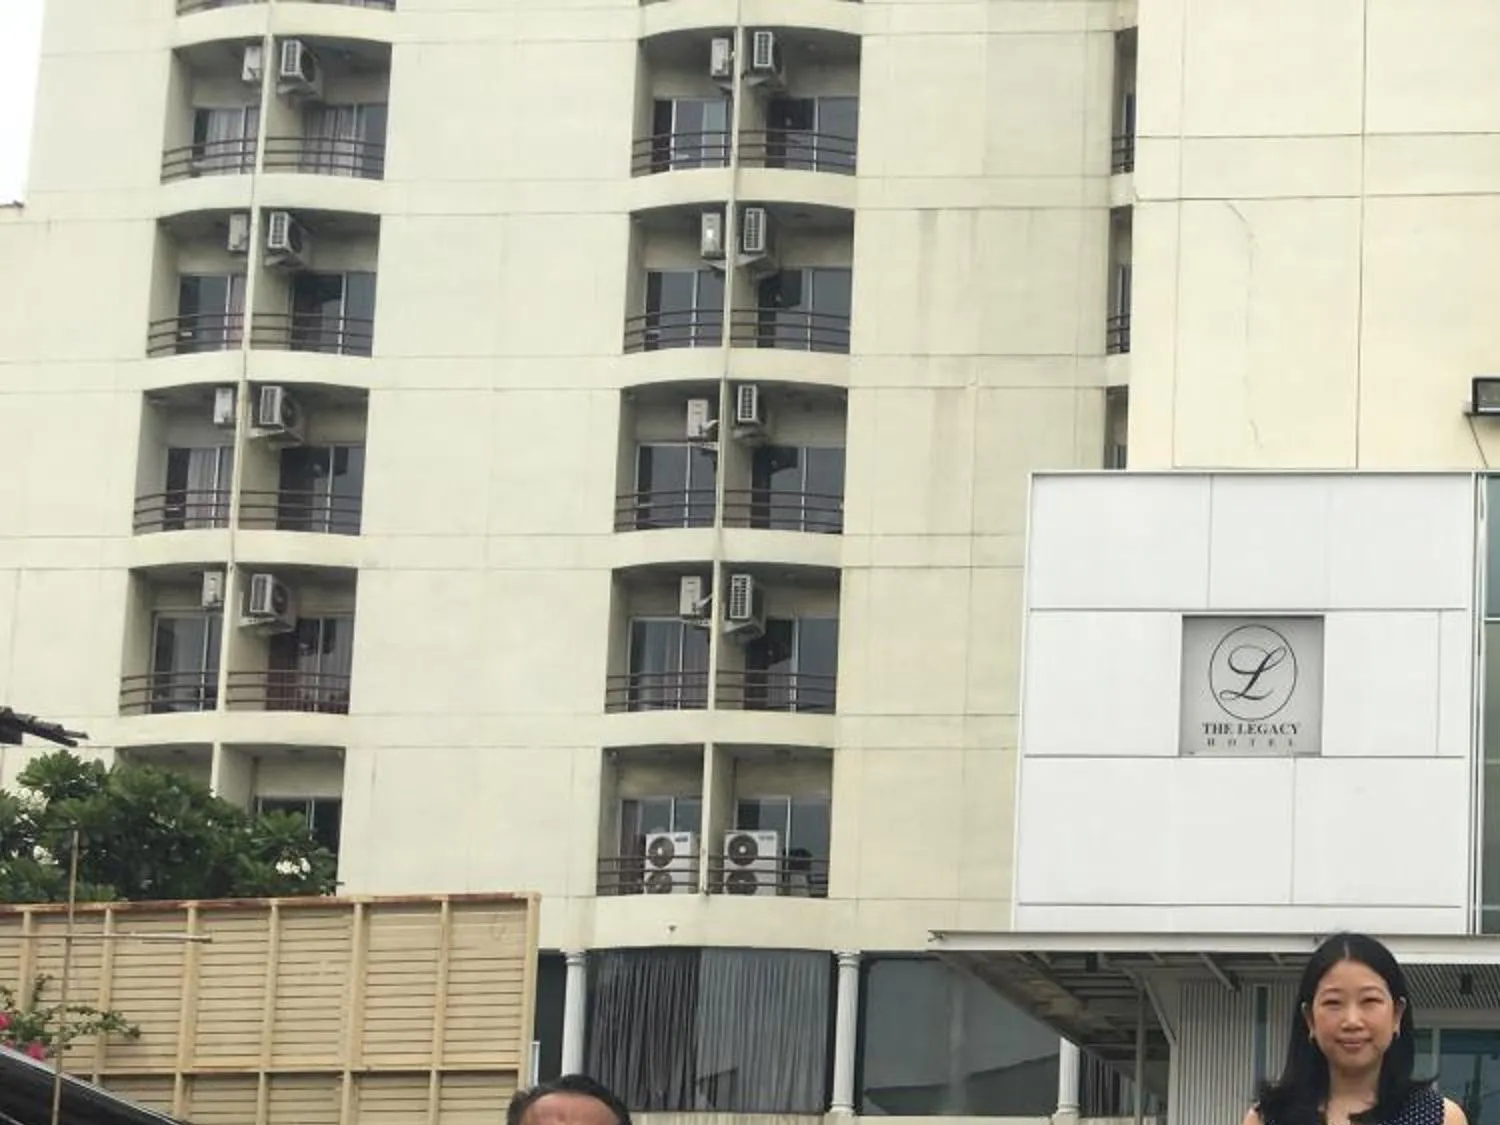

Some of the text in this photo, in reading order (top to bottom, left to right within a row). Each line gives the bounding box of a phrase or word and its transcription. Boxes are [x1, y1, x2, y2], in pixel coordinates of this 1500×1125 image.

[1202, 722, 1299, 735] THE LEGACY
[1207, 738, 1294, 748] HOTEL
